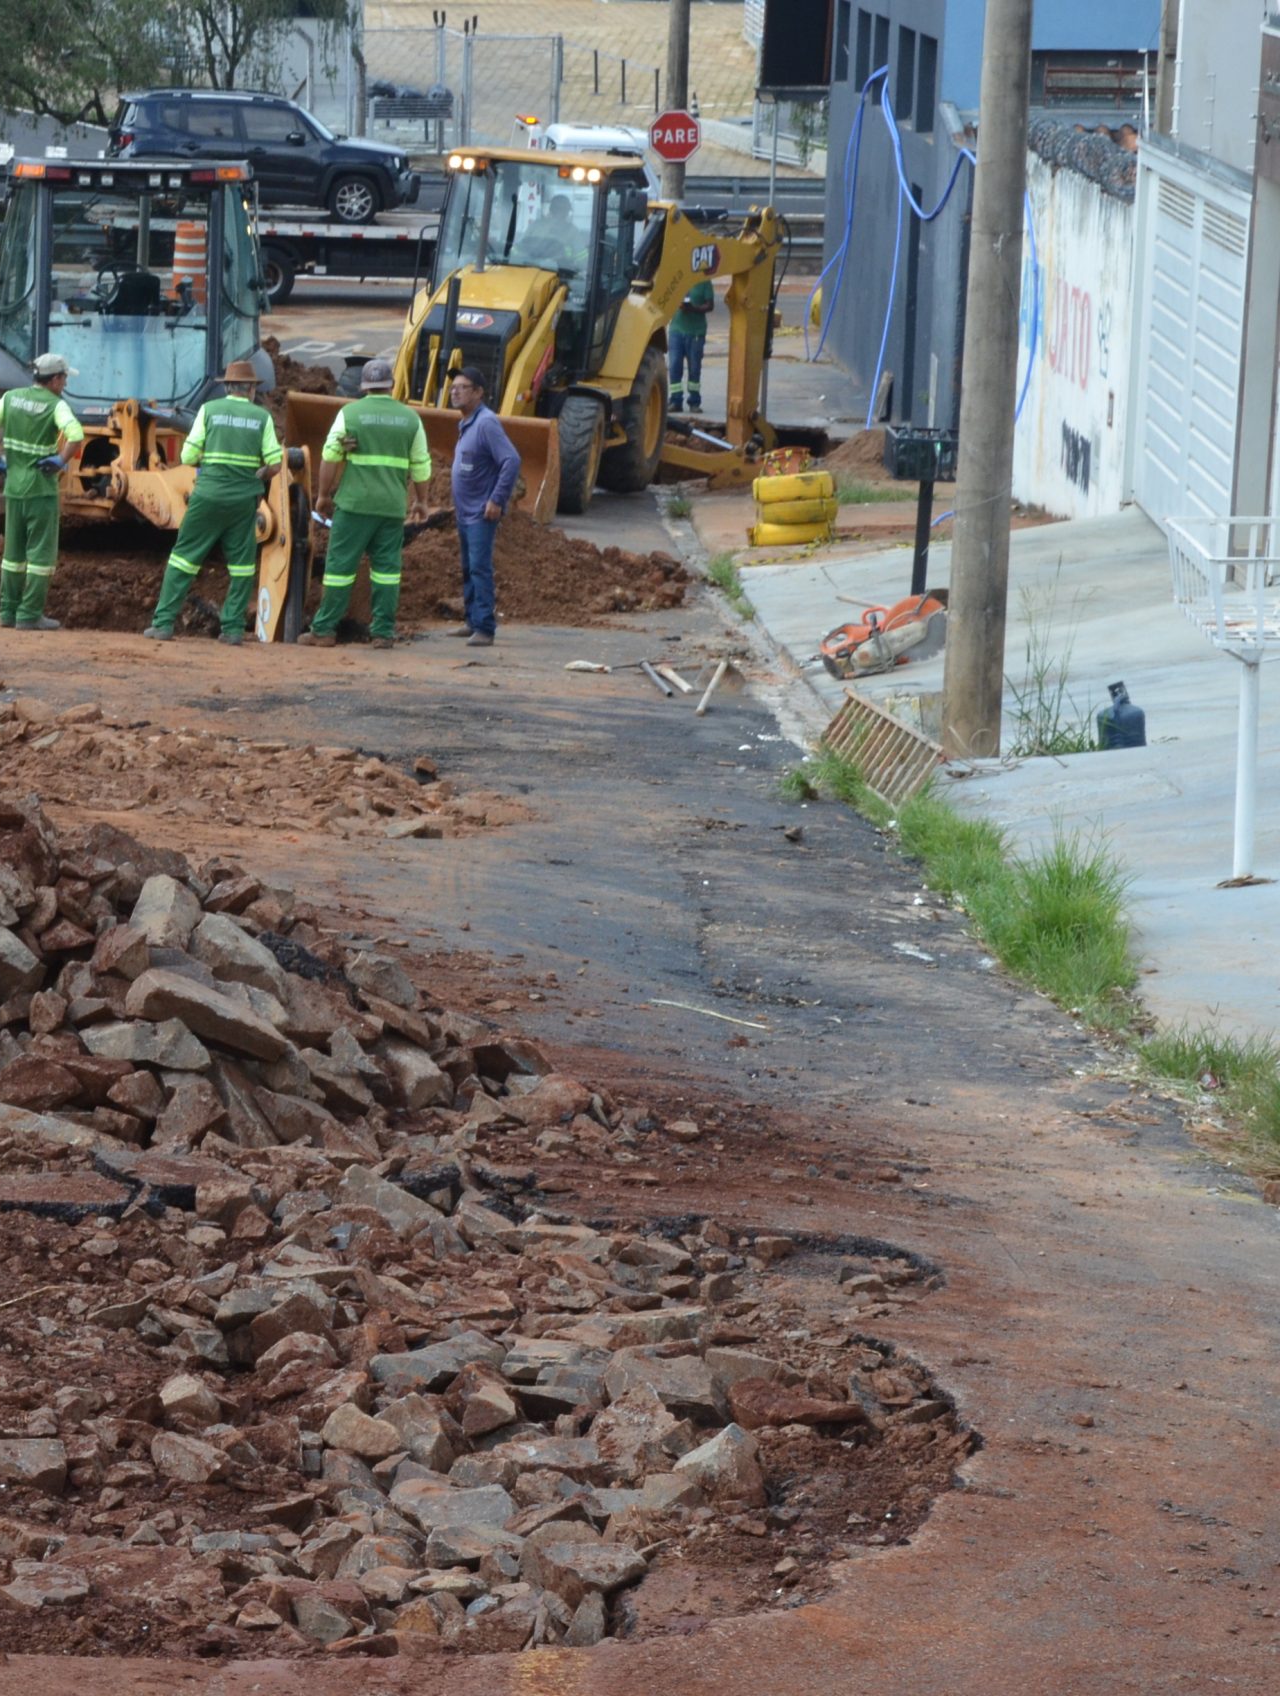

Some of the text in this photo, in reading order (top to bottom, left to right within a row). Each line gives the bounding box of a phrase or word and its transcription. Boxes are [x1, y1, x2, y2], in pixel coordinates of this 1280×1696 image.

[653, 128, 697, 144] PARE
[692, 245, 715, 271] CAT
[456, 311, 484, 325] AT
